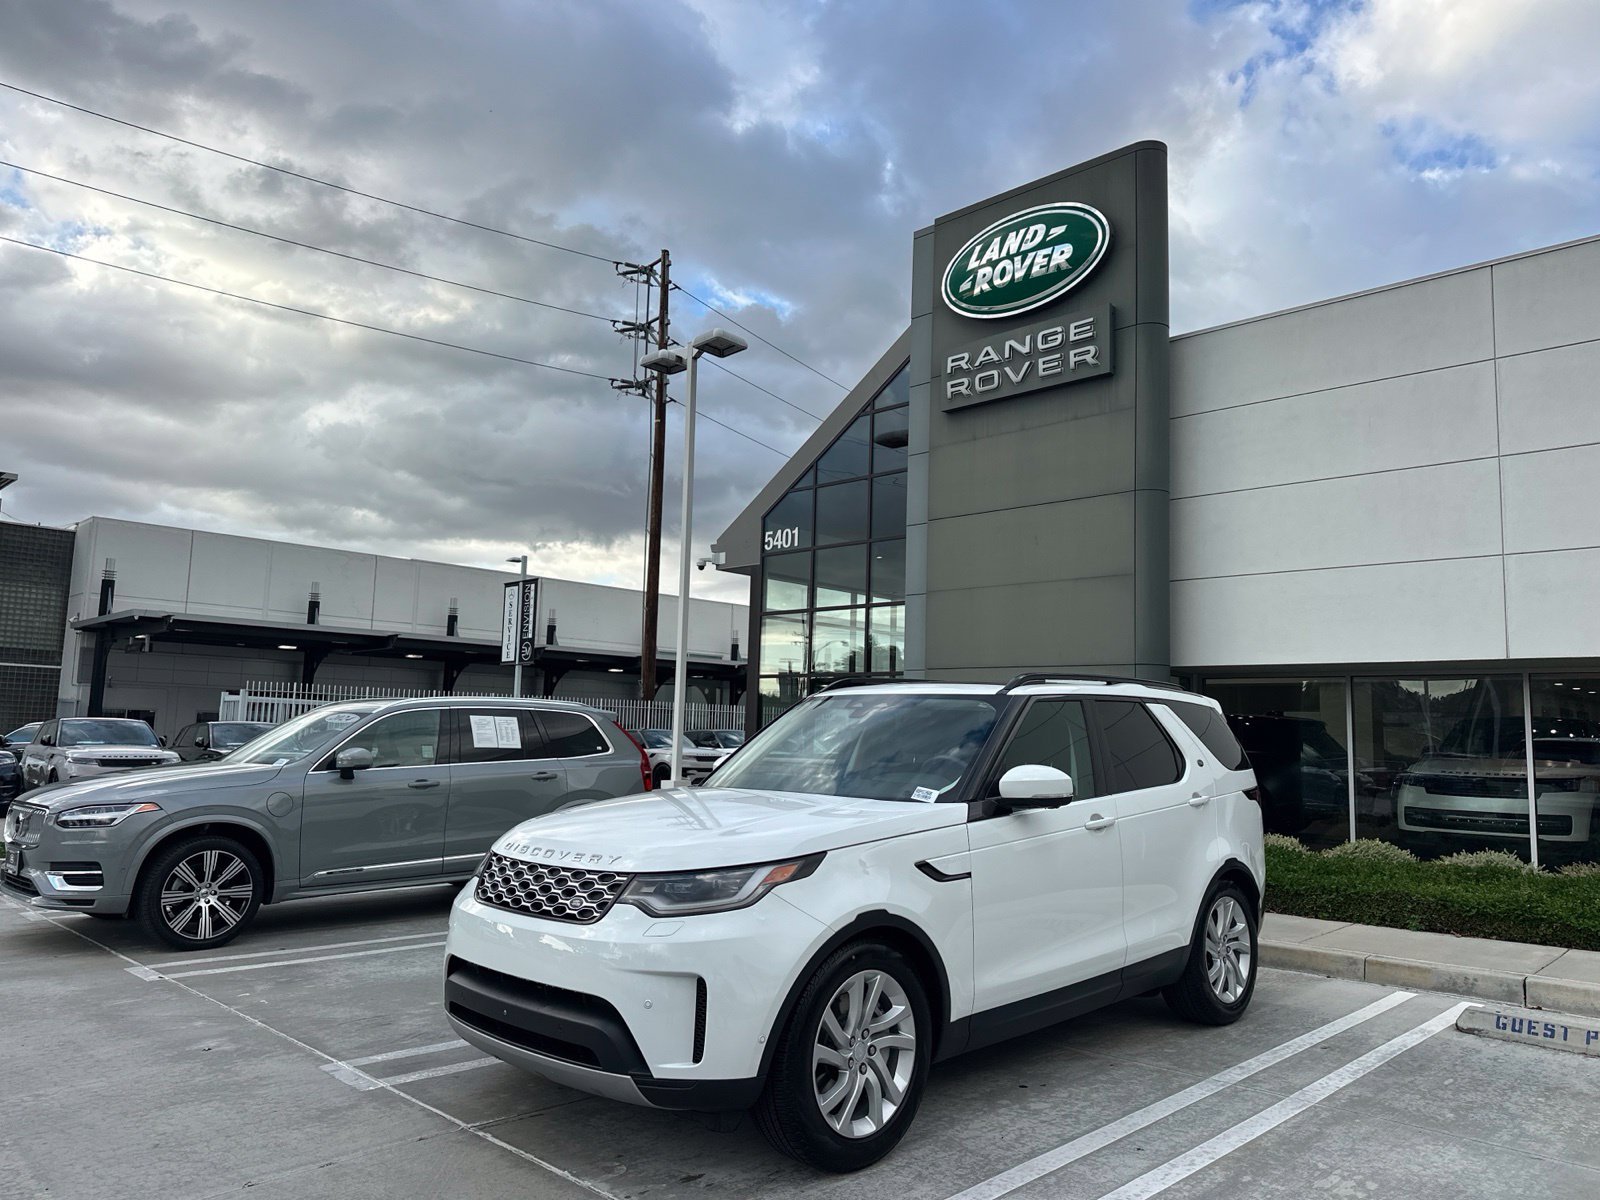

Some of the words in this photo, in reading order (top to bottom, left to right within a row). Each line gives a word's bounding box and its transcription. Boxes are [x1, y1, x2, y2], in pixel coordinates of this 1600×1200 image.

[966, 223, 1047, 272] LAND
[973, 243, 1074, 297] ROVER
[947, 317, 1097, 375] RANGE
[947, 345, 1100, 400] ROVER
[764, 527, 799, 551] 5401
[505, 601, 514, 659] SERVICE
[522, 584, 531, 639] ENVISION
[504, 842, 622, 865] DISCOVERY
[1495, 1014, 1569, 1042] GUEST
